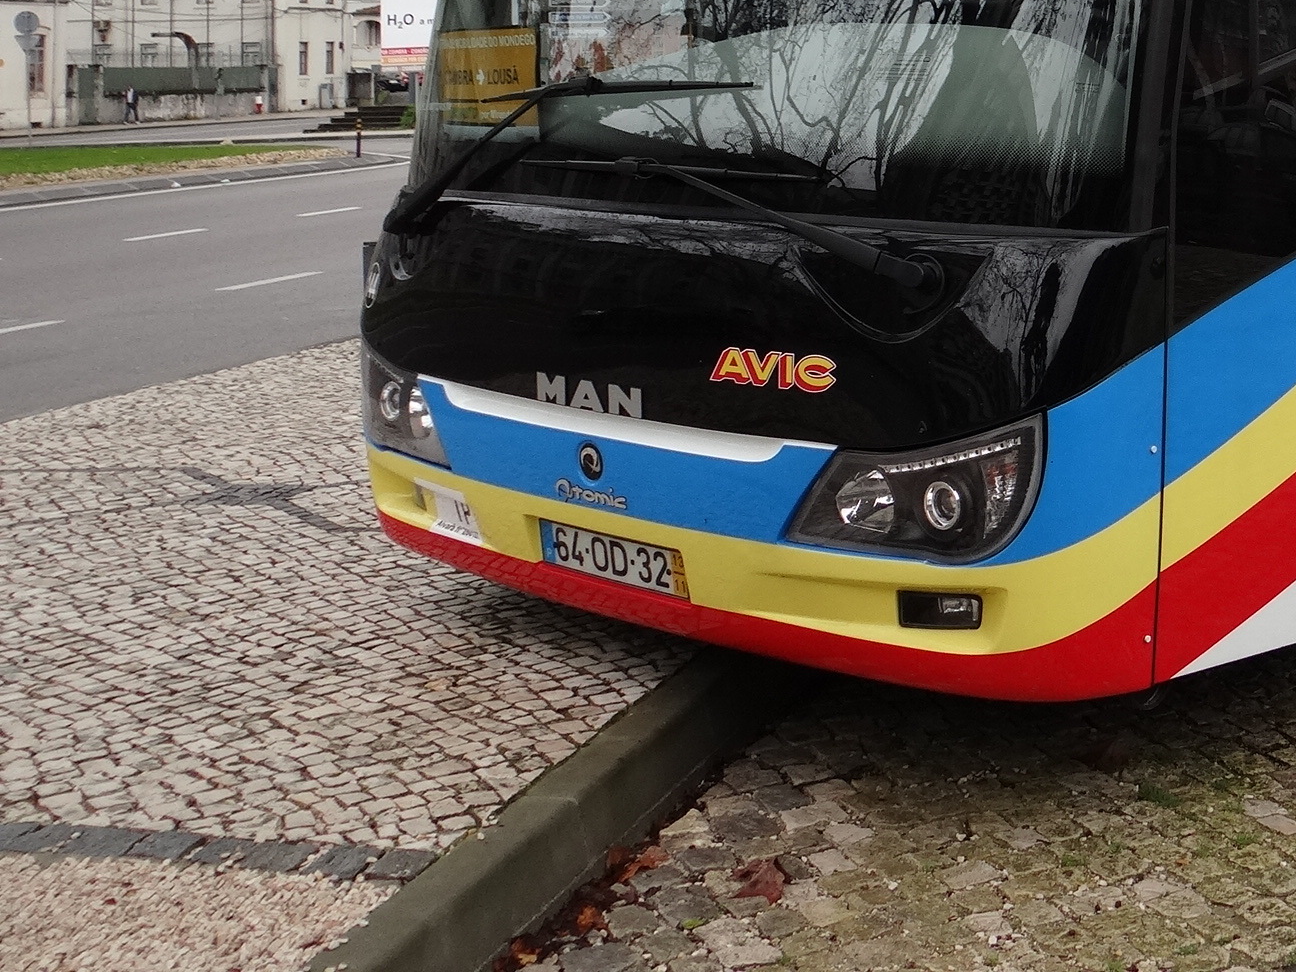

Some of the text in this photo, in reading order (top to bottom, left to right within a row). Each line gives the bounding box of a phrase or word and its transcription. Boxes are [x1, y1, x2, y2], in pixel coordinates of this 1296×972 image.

[498, 33, 536, 47] MONDEGO
[709, 346, 838, 393] AVIC
[535, 371, 643, 419] MAN
[555, 526, 670, 589] 64-OD-32
[672, 553, 684, 569] 13
[674, 579, 687, 594] 11
